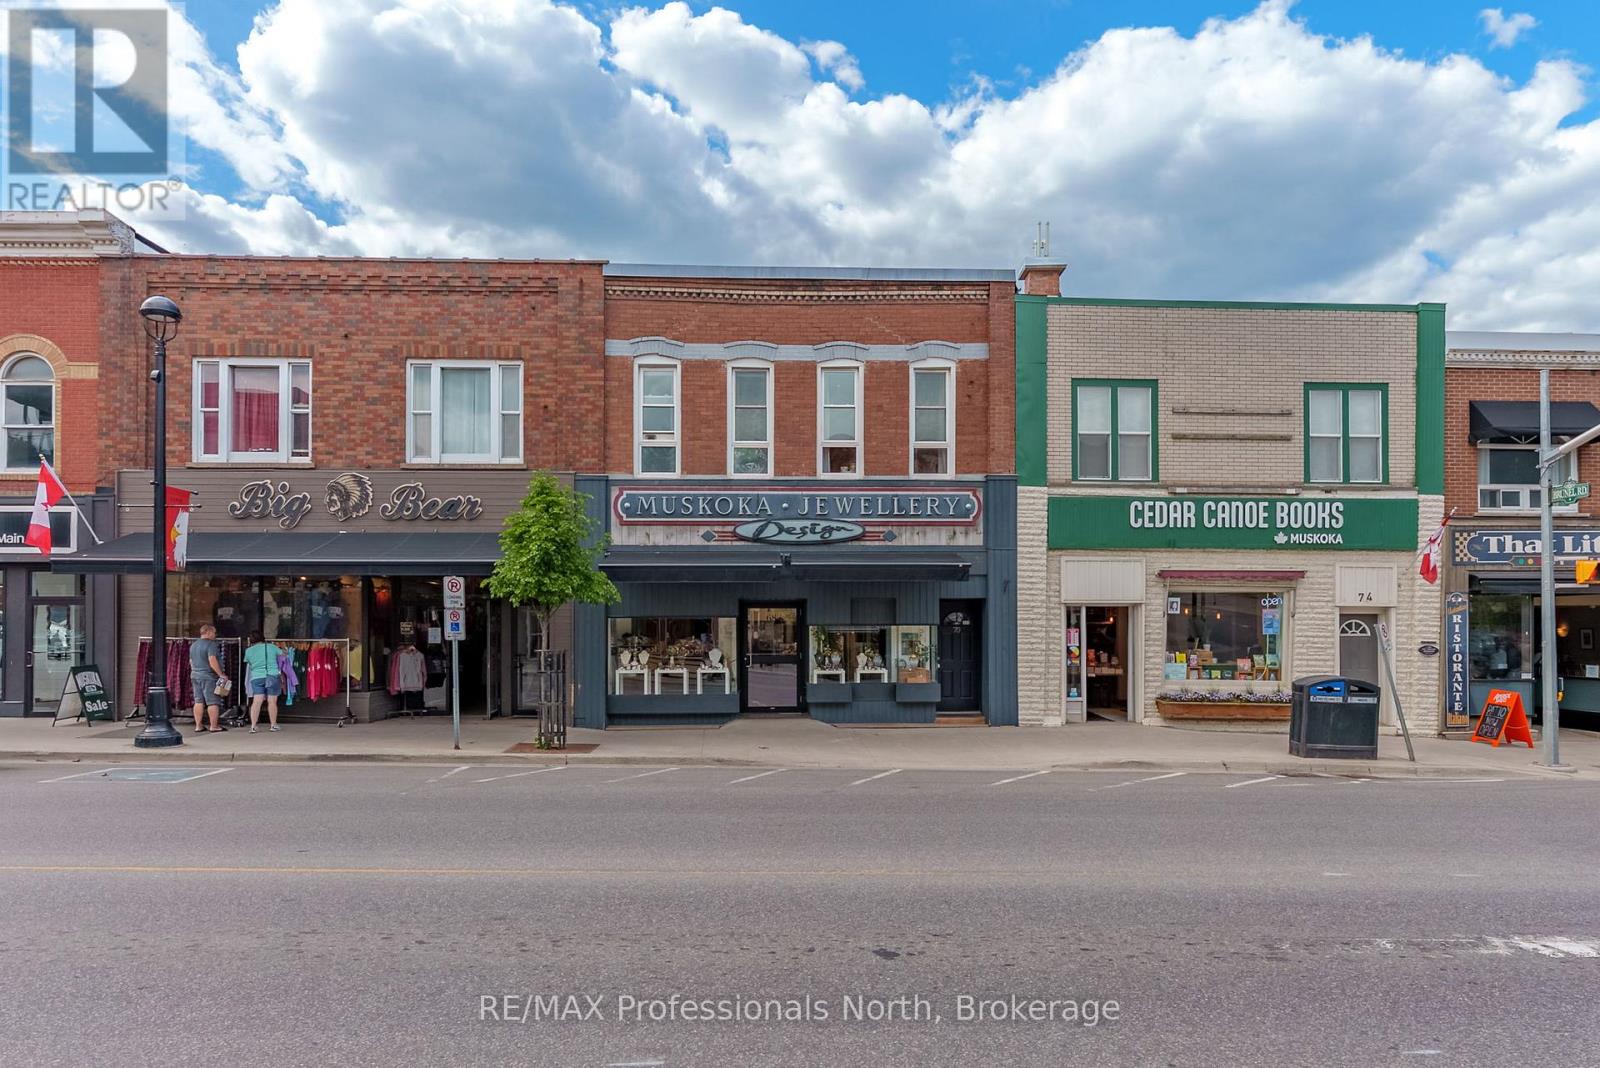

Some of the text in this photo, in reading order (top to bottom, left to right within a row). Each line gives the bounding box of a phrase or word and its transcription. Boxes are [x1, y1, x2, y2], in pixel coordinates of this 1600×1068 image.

[227, 479, 483, 529] Big Bear
[636, 496, 960, 515] MUSKOKA JEWELLERY
[1130, 501, 1344, 529] CEDAR CANOE BOOKS
[751, 519, 854, 541] Design
[1290, 532, 1343, 544] MUSKOKA
[1482, 534, 1557, 554] Tha
[1261, 597, 1283, 607] open
[1358, 592, 1373, 602] 74
[1452, 614, 1463, 711] RISTORANTE
[84, 699, 109, 713] Sale
